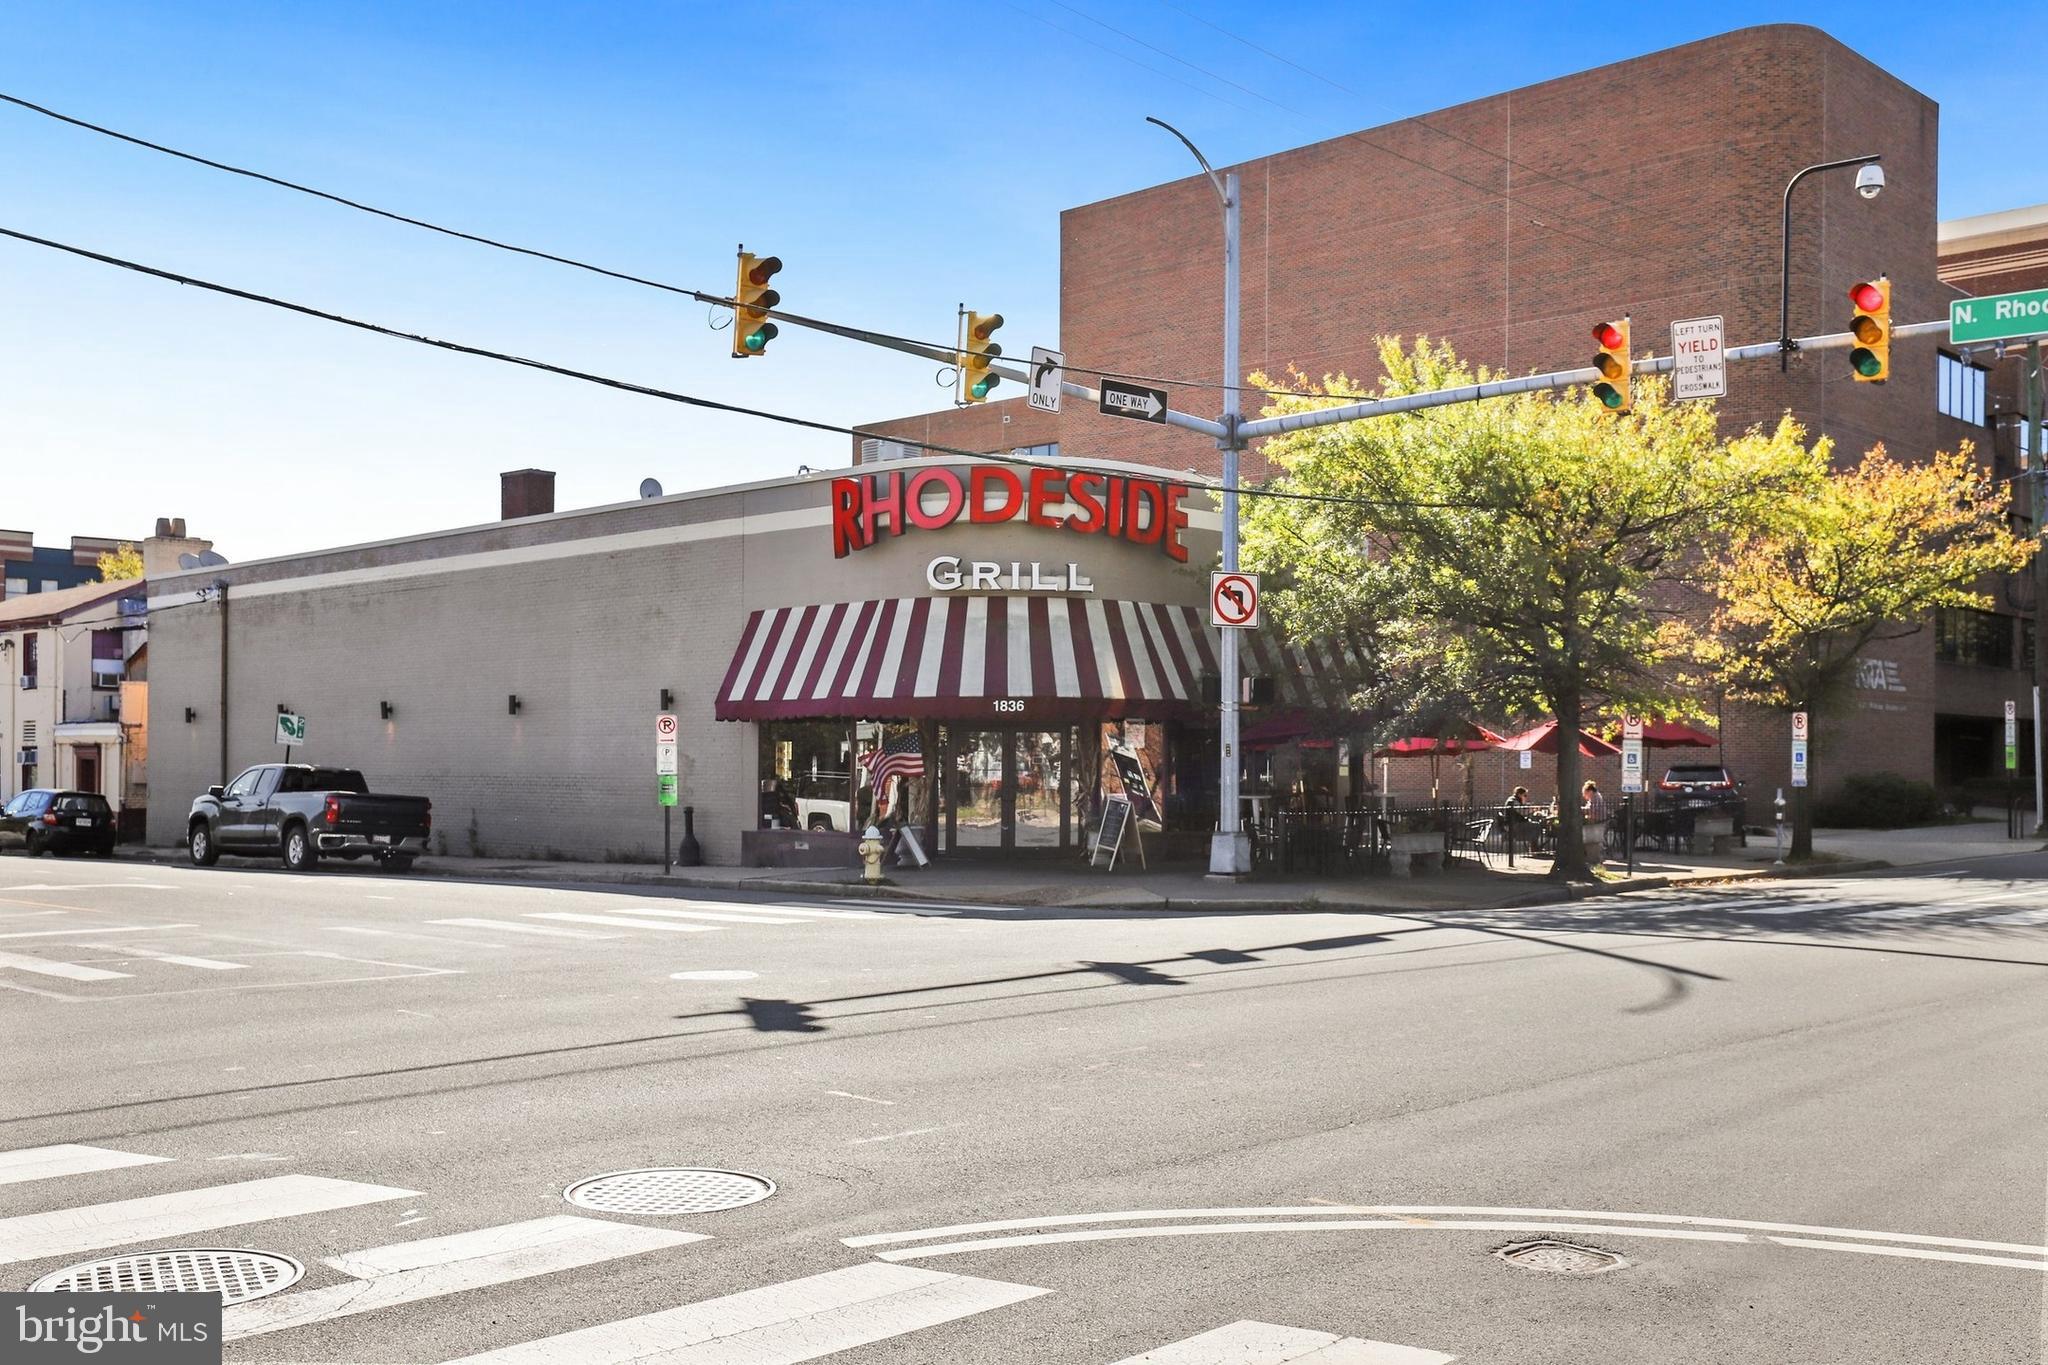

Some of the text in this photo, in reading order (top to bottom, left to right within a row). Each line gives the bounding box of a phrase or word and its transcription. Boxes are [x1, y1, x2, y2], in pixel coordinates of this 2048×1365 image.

[1955, 304, 1978, 325] N.
[1675, 323, 1720, 337] LEFT TURN
[1678, 338, 1718, 353] YIELD
[1693, 355, 1704, 363] TO
[1675, 363, 1722, 375] PEDESTRIANS
[1680, 382, 1720, 392] CROSSWALK
[1032, 392, 1056, 408] ONLY
[1109, 393, 1149, 409] ONE WAY
[832, 465, 1189, 563] RHODESIDE
[926, 556, 1094, 593] GRILL
[993, 700, 1025, 711] 1836
